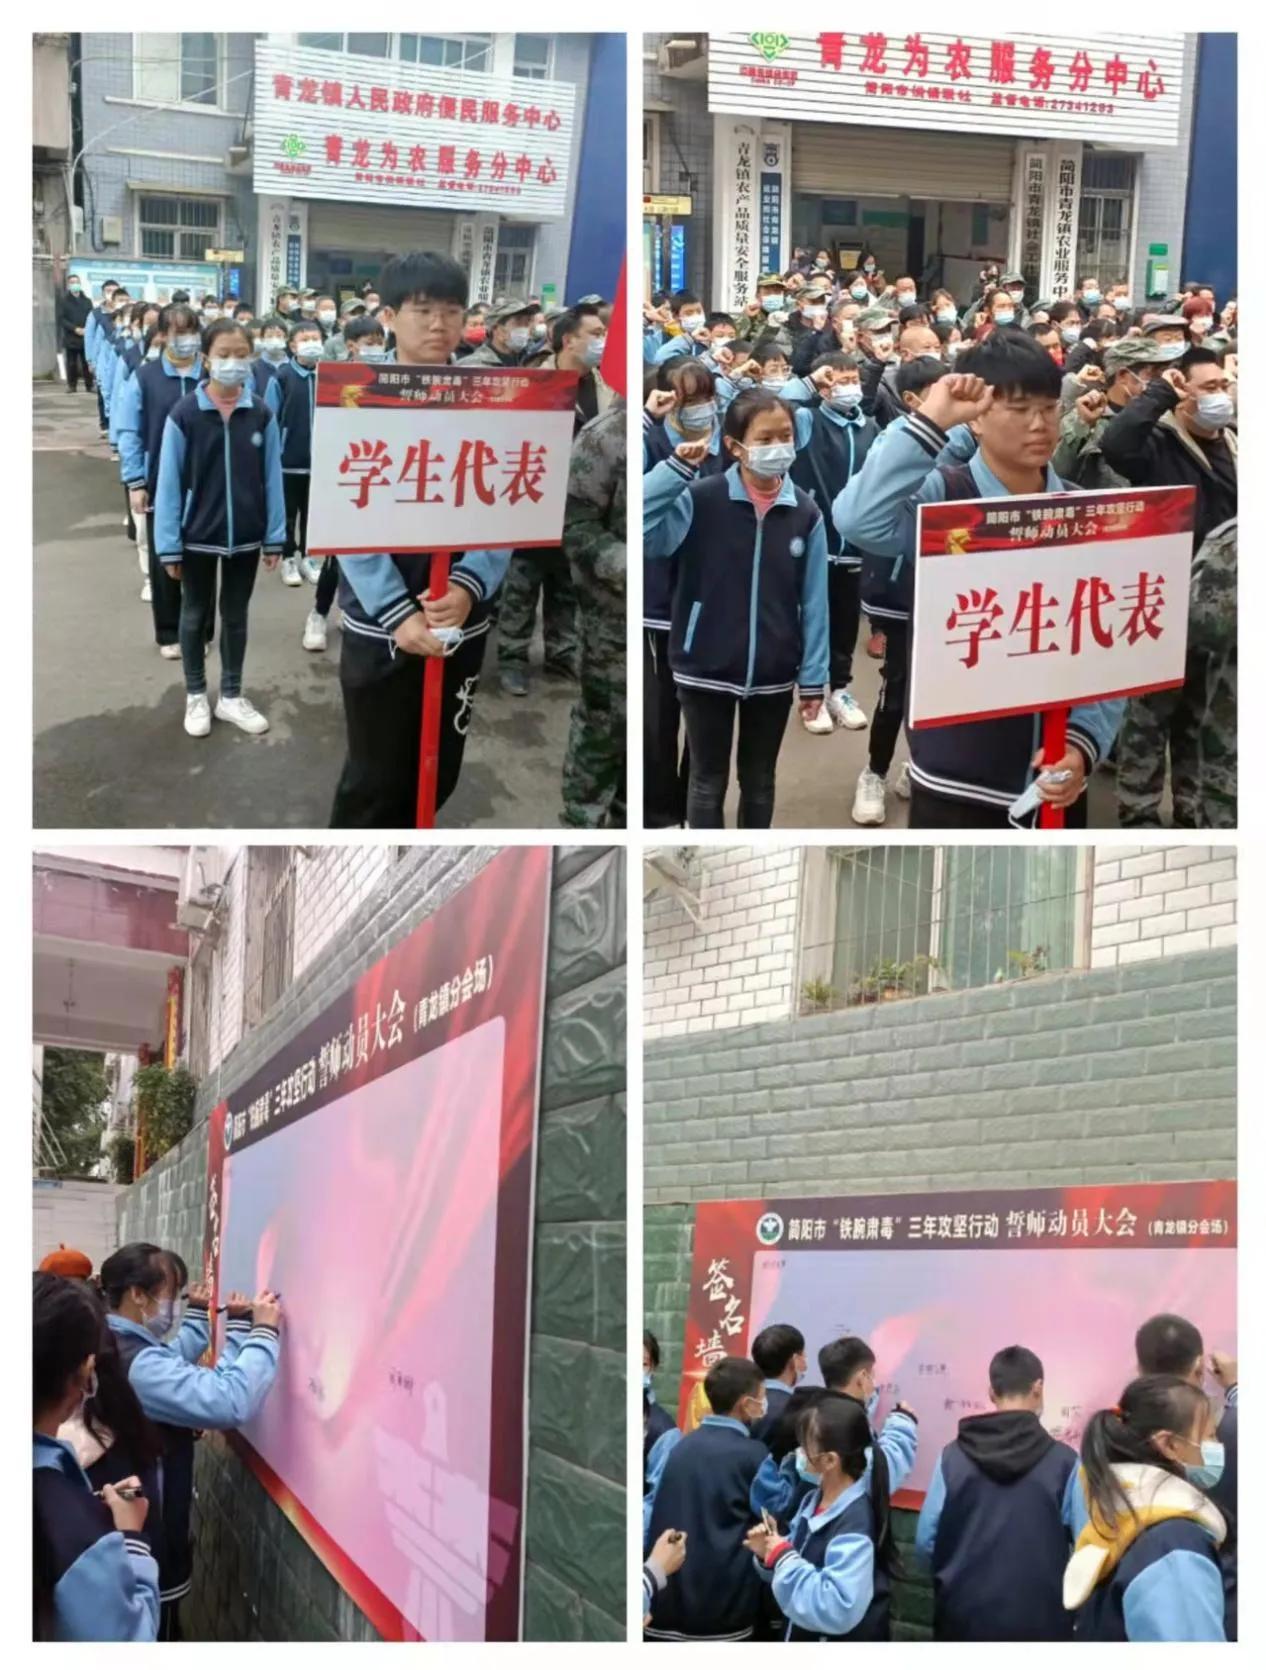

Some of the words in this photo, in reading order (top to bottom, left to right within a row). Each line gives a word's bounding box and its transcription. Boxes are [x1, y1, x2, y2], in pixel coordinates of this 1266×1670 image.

[273, 74, 561, 131] 青龙镇人民政府便民服务中心
[324, 134, 557, 184] 青龙为农服务分中心
[338, 438, 548, 509] 学生代表
[945, 571, 1166, 669] 学生代表
[1005, 1207, 1137, 1239] 誓师动员大会
[694, 1258, 745, 1367] 签名墙
